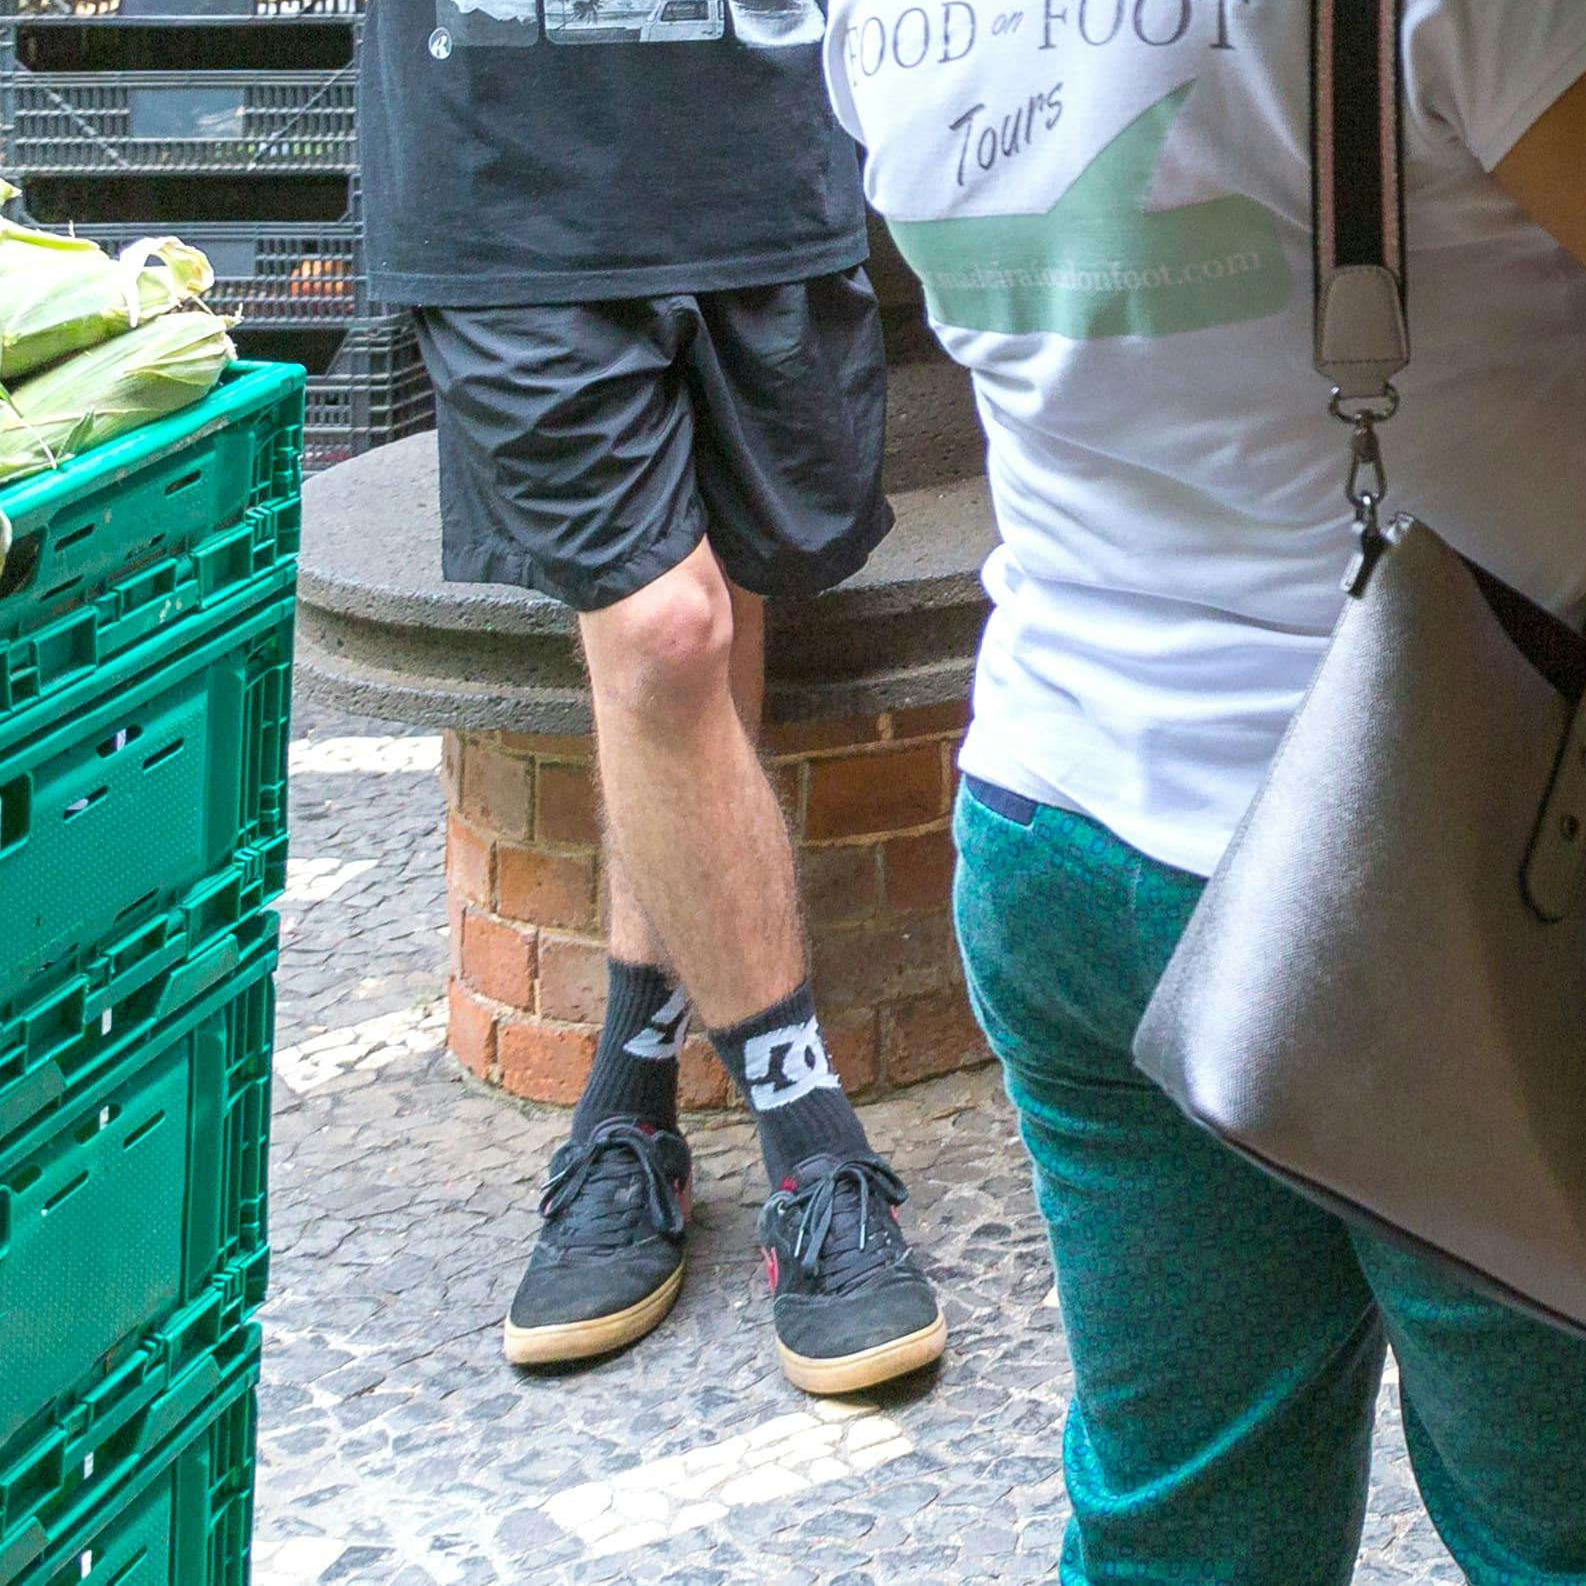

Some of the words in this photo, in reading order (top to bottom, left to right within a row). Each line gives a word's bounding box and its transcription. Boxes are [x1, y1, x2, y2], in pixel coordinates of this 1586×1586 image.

[844, 0, 977, 87] FOOD
[991, 8, 1024, 37] on
[948, 81, 1066, 187] Tours
